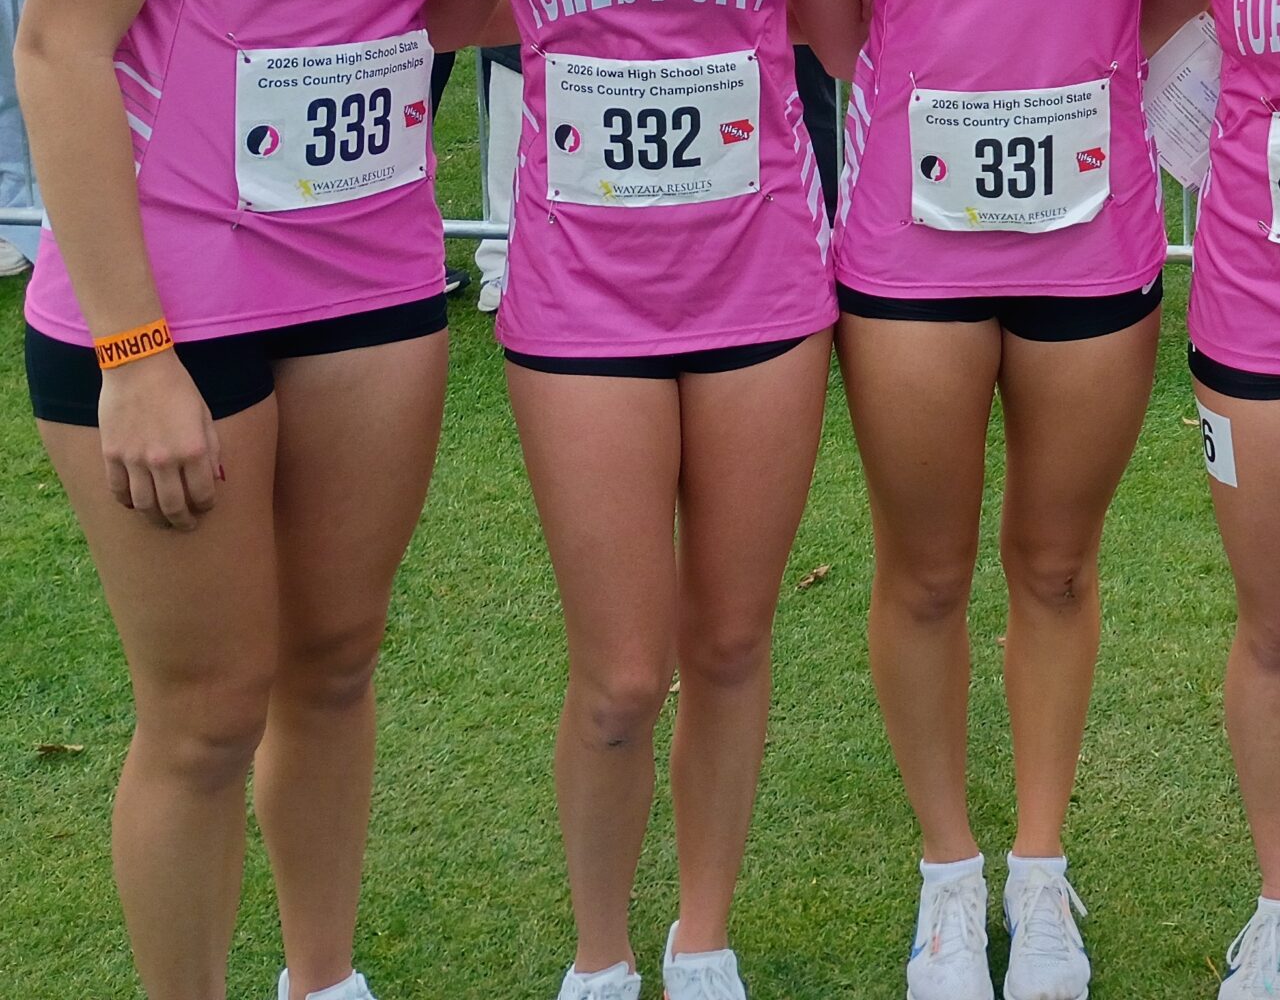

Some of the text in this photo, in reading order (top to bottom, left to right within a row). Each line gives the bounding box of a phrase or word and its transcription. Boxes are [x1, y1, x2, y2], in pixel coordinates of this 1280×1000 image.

[267, 41, 418, 69] 2026 Iowa High School State
[258, 57, 424, 88] Cross Country Championships
[567, 62, 736, 81] 2026 Iowa High School State
[560, 78, 744, 99] Cross Country Championships
[932, 91, 1092, 110] 2026 Iowa High School State
[305, 87, 391, 166] 333
[926, 107, 1098, 128] Cross Country Championships
[602, 106, 701, 171] 332
[312, 177, 360, 191] WAYZATA
[362, 166, 395, 179] RESULTS
[975, 134, 1053, 199] 331
[613, 183, 664, 194] WAYZATA
[667, 180, 712, 192] RESULTS
[977, 212, 1024, 221] WAYZATA
[1028, 206, 1067, 221] RESULTS
[1202, 418, 1215, 462] 6
